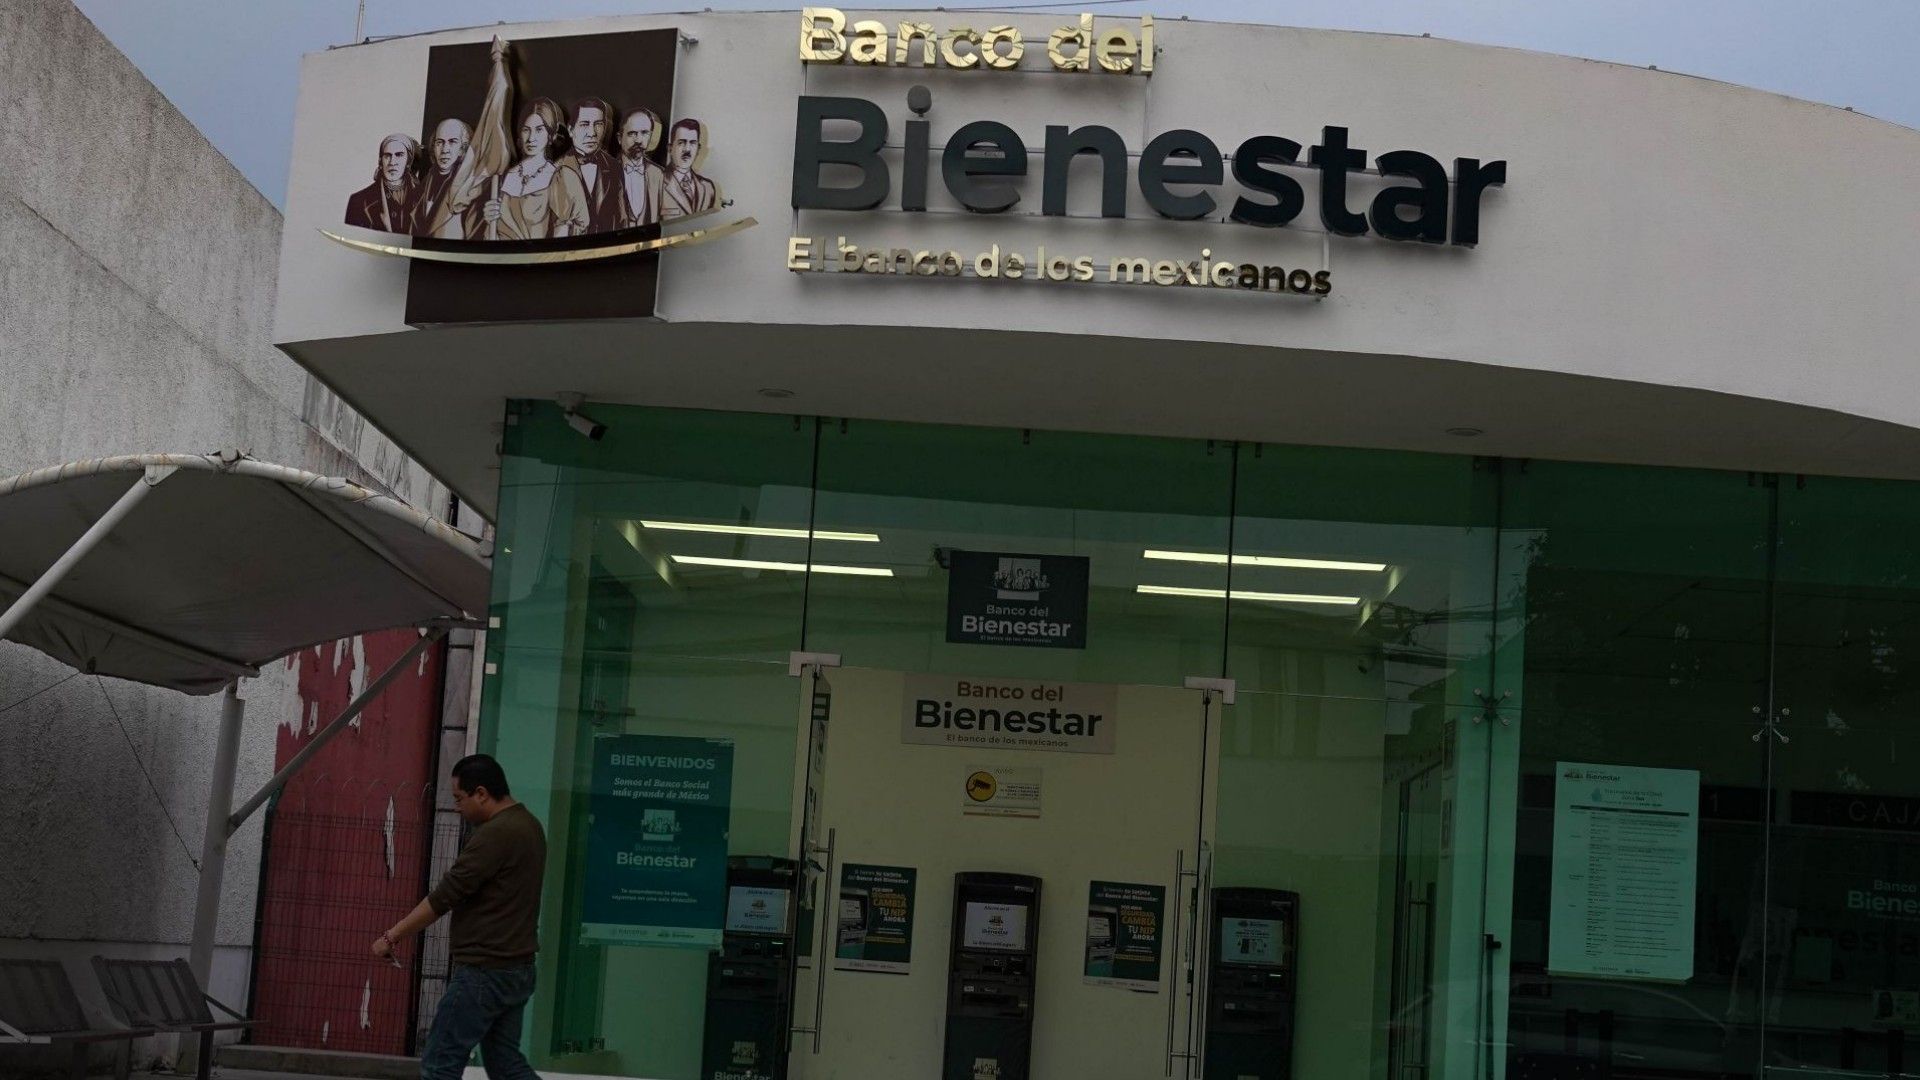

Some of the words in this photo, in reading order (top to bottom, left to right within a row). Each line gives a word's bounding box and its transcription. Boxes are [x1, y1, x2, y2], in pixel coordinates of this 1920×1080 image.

[799, 6, 1025, 69] Banco
[1047, 12, 1154, 76] del
[791, 85, 1507, 248] Bienestar
[787, 236, 825, 272] El
[837, 236, 963, 277] banco
[974, 243, 1026, 279] de
[1037, 246, 1094, 281] los
[1109, 248, 1332, 295] mexicanos
[986, 603, 1026, 616] Banco
[1029, 606, 1049, 617] del
[962, 615, 1071, 637] Bienestar
[957, 681, 1024, 699] Banco
[1031, 684, 1063, 702] del
[915, 699, 1102, 736] Bienestar
[946, 733, 955, 742] El
[957, 734, 986, 744] banco
[988, 736, 1000, 744] de
[1002, 736, 1016, 745] los
[1018, 738, 1068, 748] mexicanos
[610, 753, 716, 770] BIENVENIDOS
[614, 777, 642, 787] Somos
[643, 778, 652, 787] el
[653, 779, 681, 788] Banco
[682, 780, 710, 790] Social
[632, 789, 664, 800] grande
[666, 790, 677, 799] de
[678, 790, 709, 801] México
[616, 851, 697, 868] Bienestar
[1847, 890, 1920, 914] Biene
[879, 907, 889, 915] TU
[1128, 925, 1138, 933] TU
